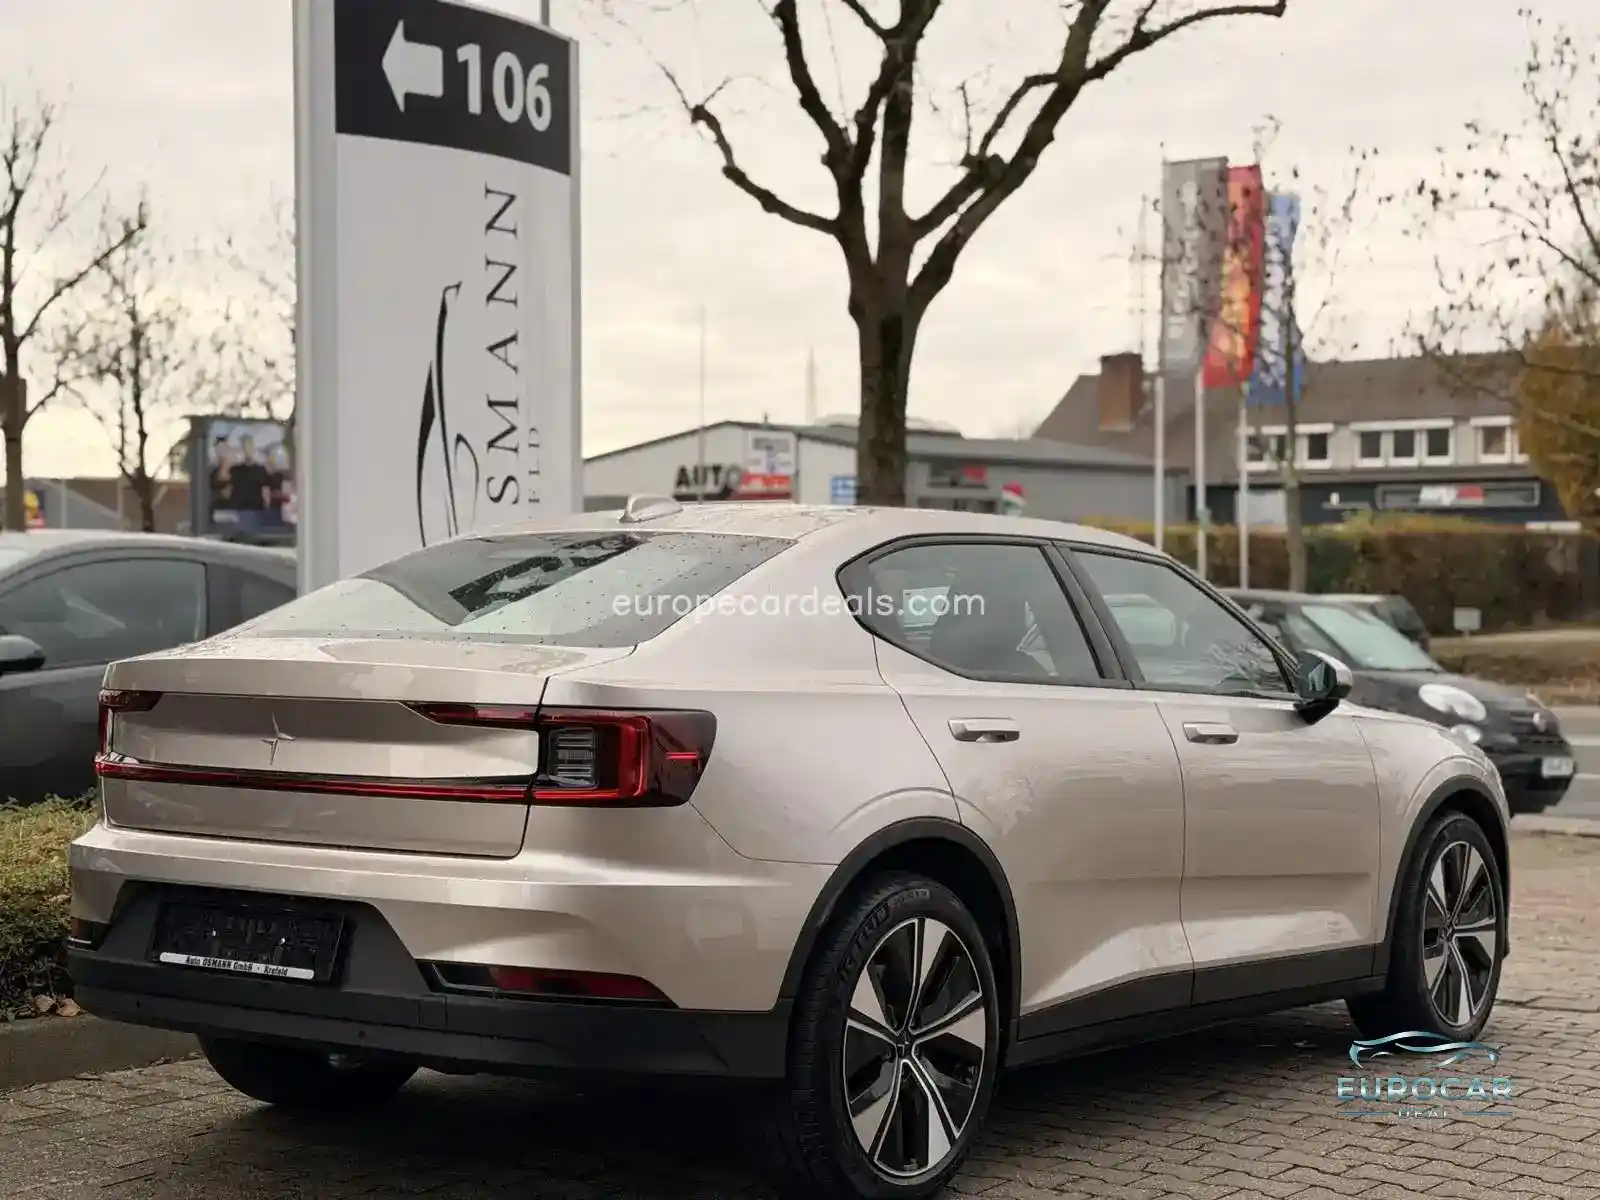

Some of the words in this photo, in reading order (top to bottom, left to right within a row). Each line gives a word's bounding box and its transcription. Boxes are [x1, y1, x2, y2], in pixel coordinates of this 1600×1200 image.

[456, 43, 552, 131] 106
[527, 427, 541, 519] ELD
[202, 958, 232, 969] OSMANN
[233, 962, 253, 972] GmbH
[263, 965, 288, 976] Krefeld
